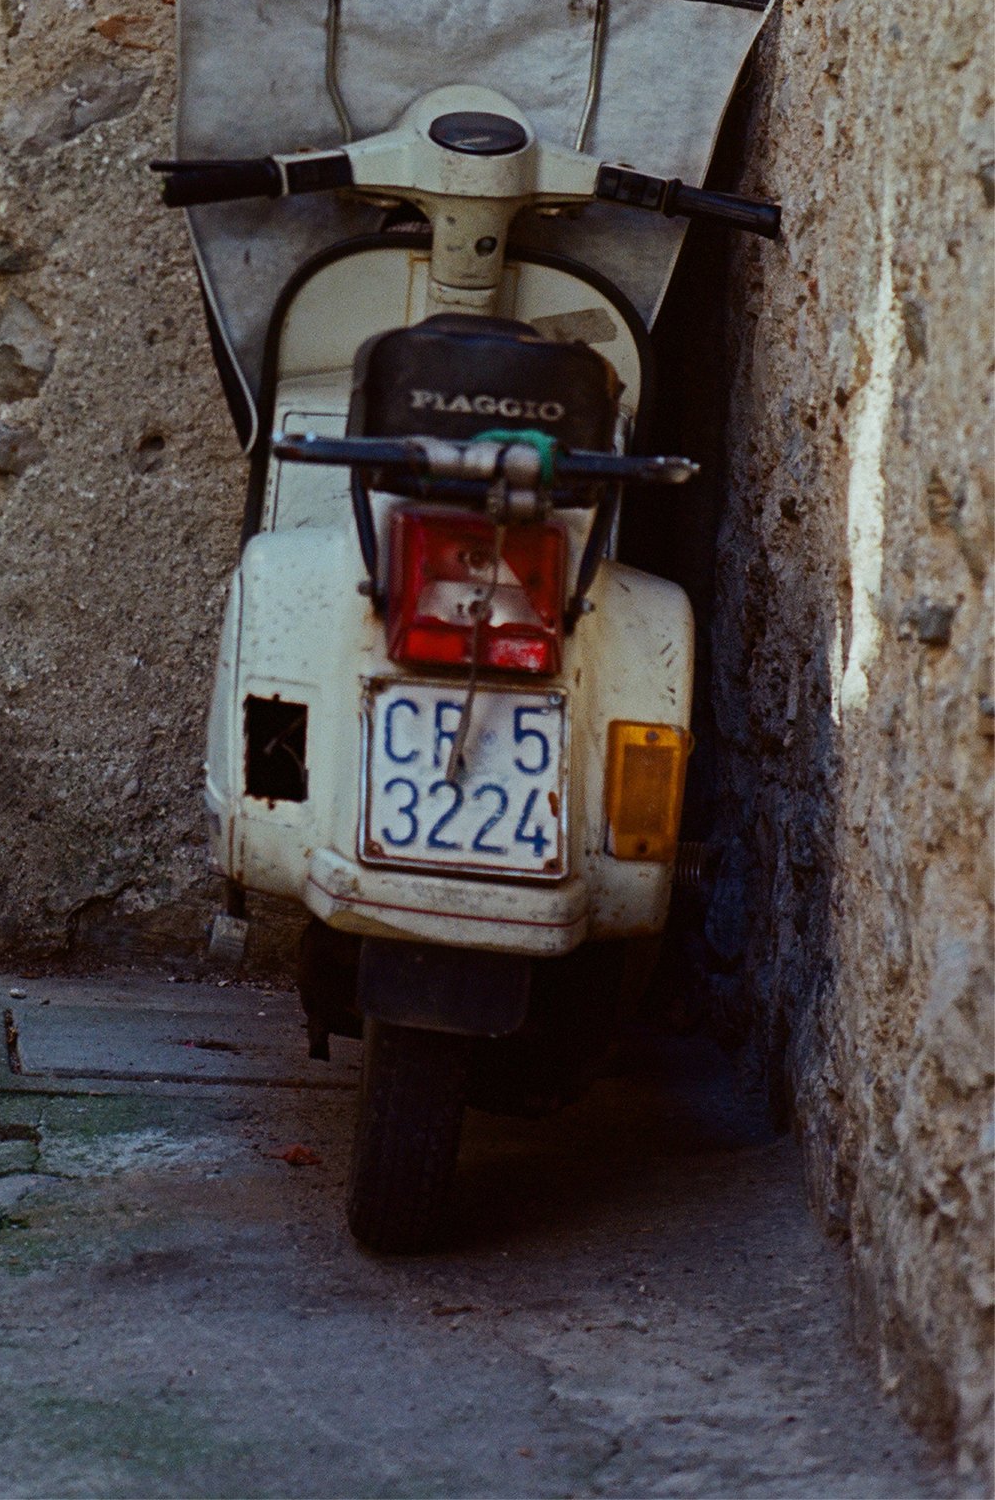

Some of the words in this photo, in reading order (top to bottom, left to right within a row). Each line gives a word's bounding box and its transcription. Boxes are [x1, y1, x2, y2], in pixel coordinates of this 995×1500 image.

[409, 388, 566, 421] PIAGGIO
[513, 705, 551, 776] 5
[381, 777, 552, 859] 3224
